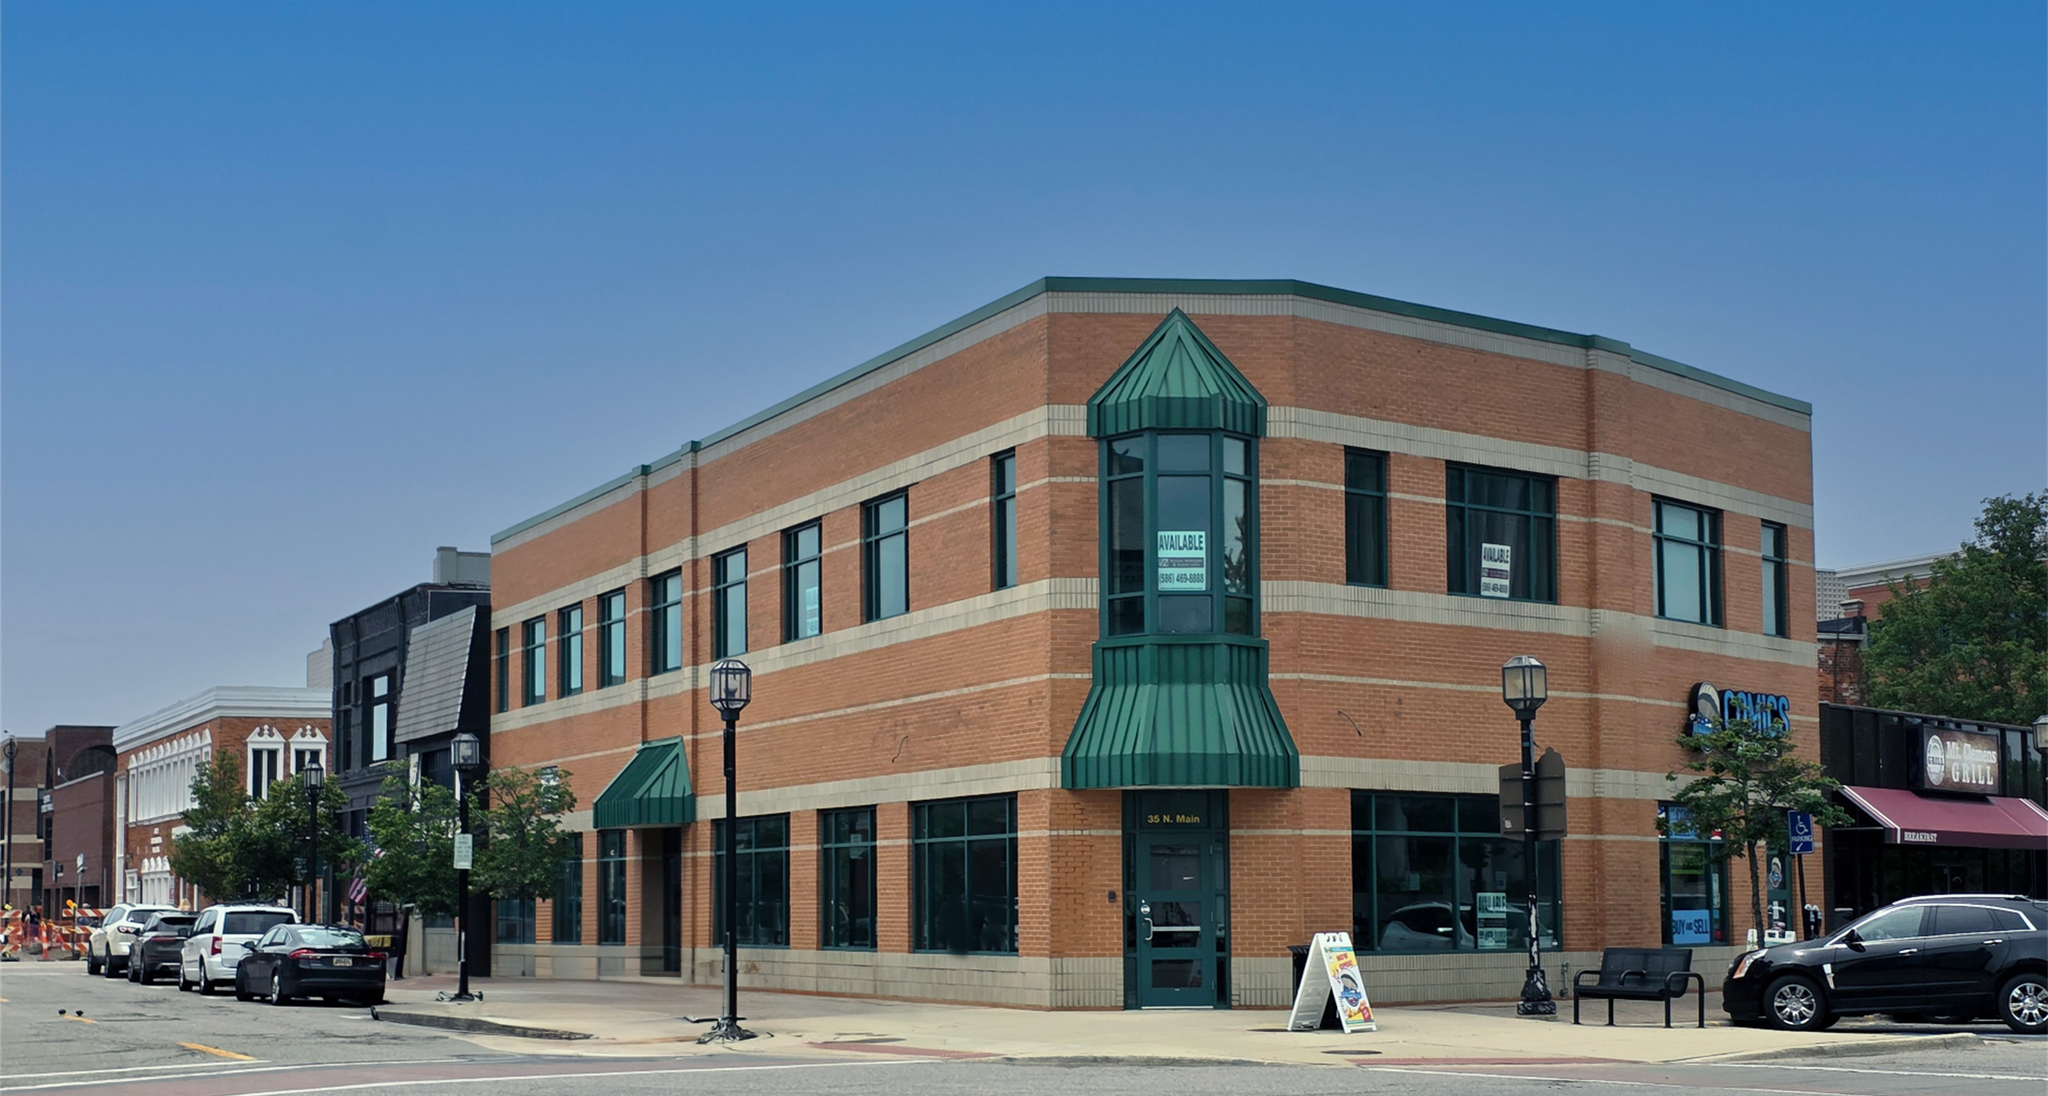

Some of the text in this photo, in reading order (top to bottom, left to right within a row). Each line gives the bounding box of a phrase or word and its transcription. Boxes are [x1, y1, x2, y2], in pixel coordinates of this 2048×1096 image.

[1159, 535, 1204, 551] AVAILABLE
[1946, 741, 1960, 758] Mt.
[1963, 743, 1997, 763] Clemens
[1928, 756, 1944, 765] GRILL
[1952, 762, 1993, 785] GRILL
[1147, 814, 1200, 824] 35 N. Main
[1672, 919, 1685, 935] BUY
[1694, 919, 1709, 934] SELL
